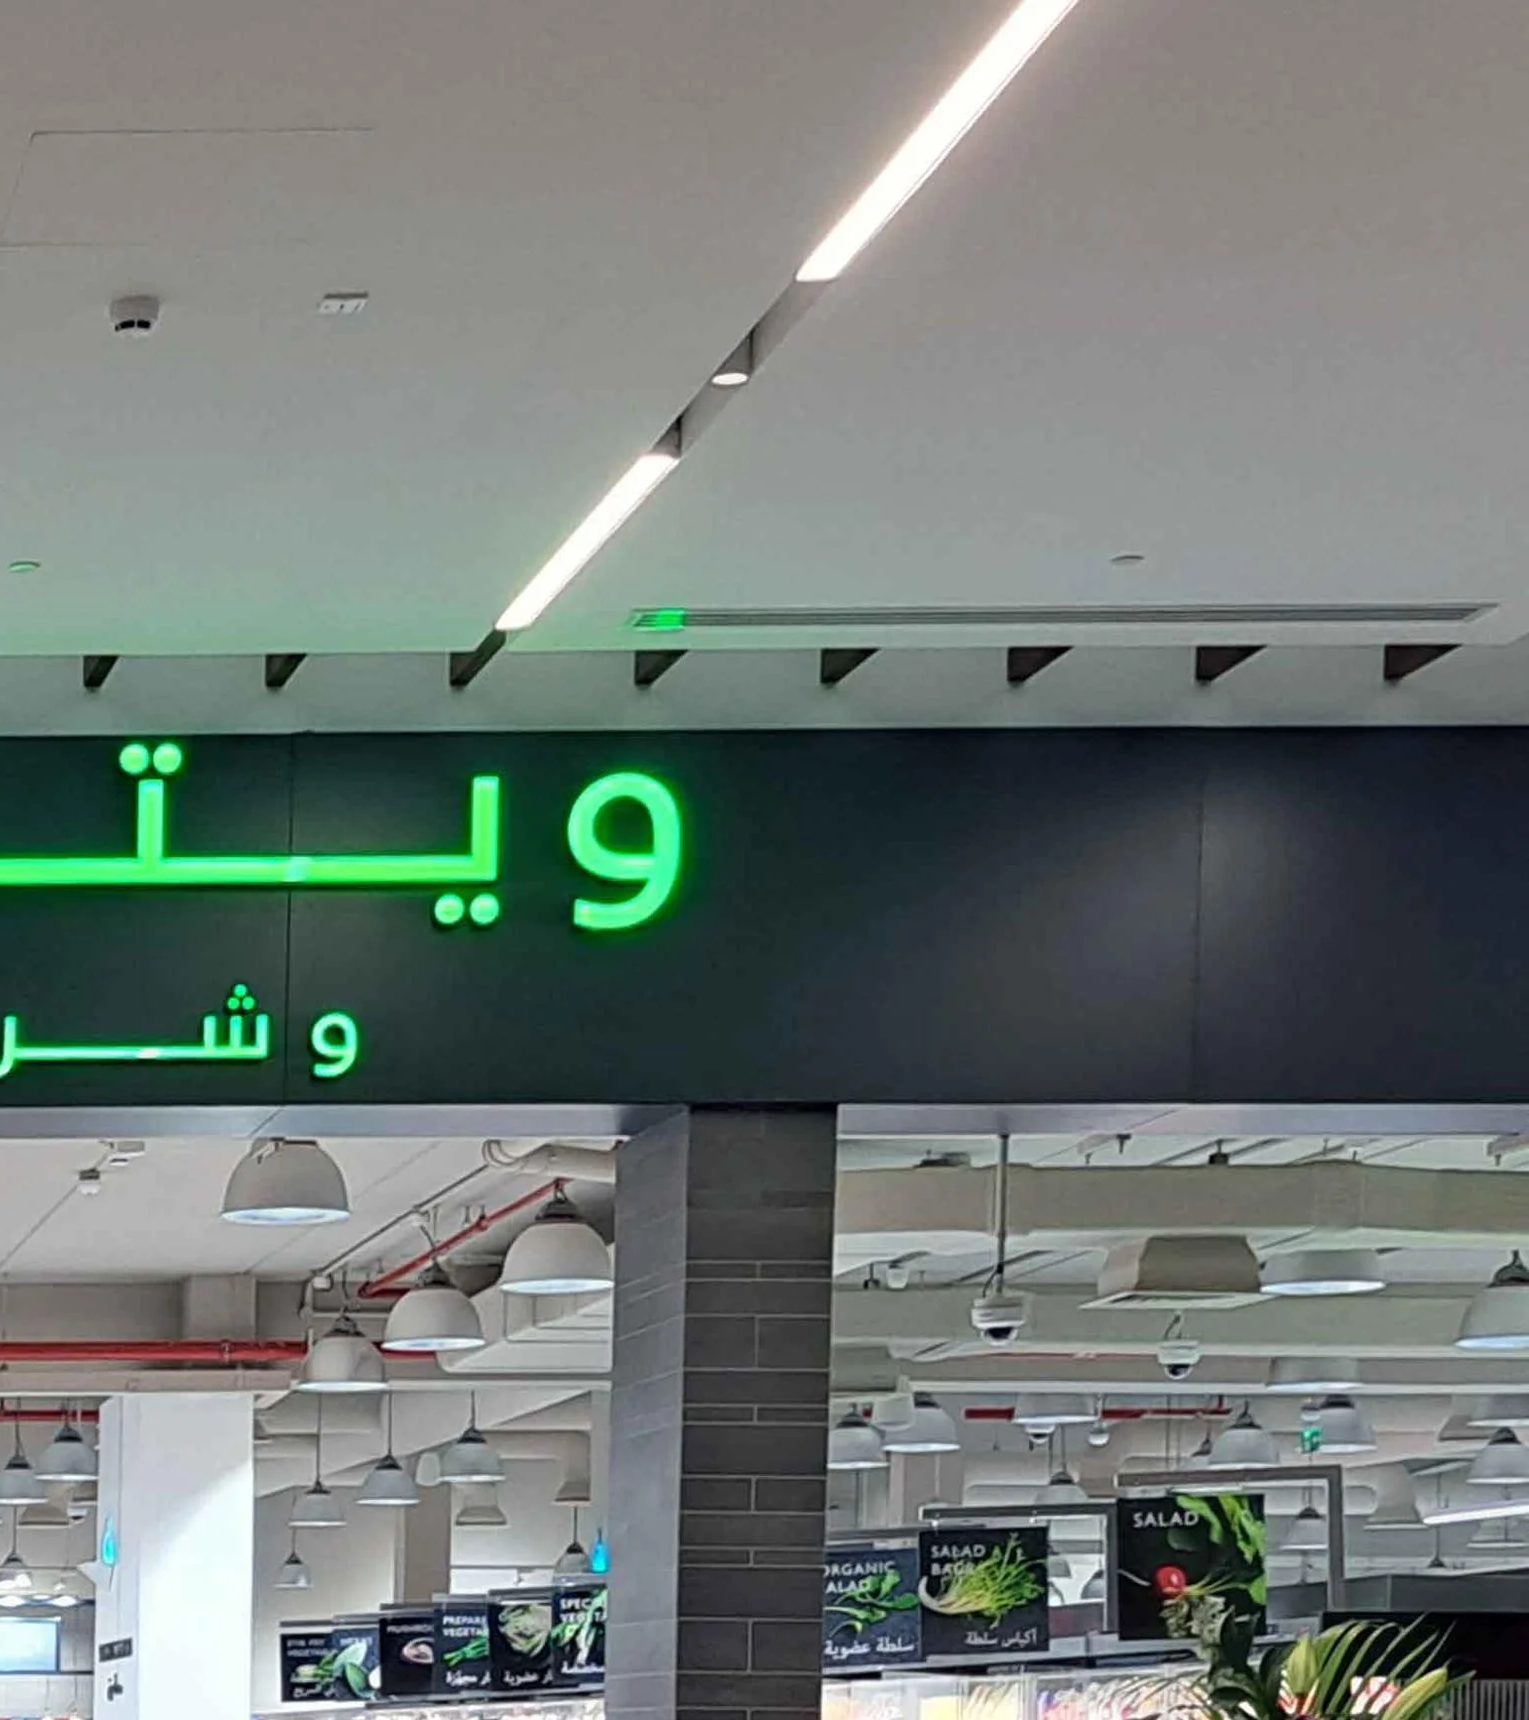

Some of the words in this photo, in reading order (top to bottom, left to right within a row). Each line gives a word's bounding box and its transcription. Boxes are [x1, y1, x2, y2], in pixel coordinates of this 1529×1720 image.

[1133, 1512, 1199, 1529] SALAD
[930, 1544, 986, 1560] SALAD
[826, 1577, 869, 1595] ALAD
